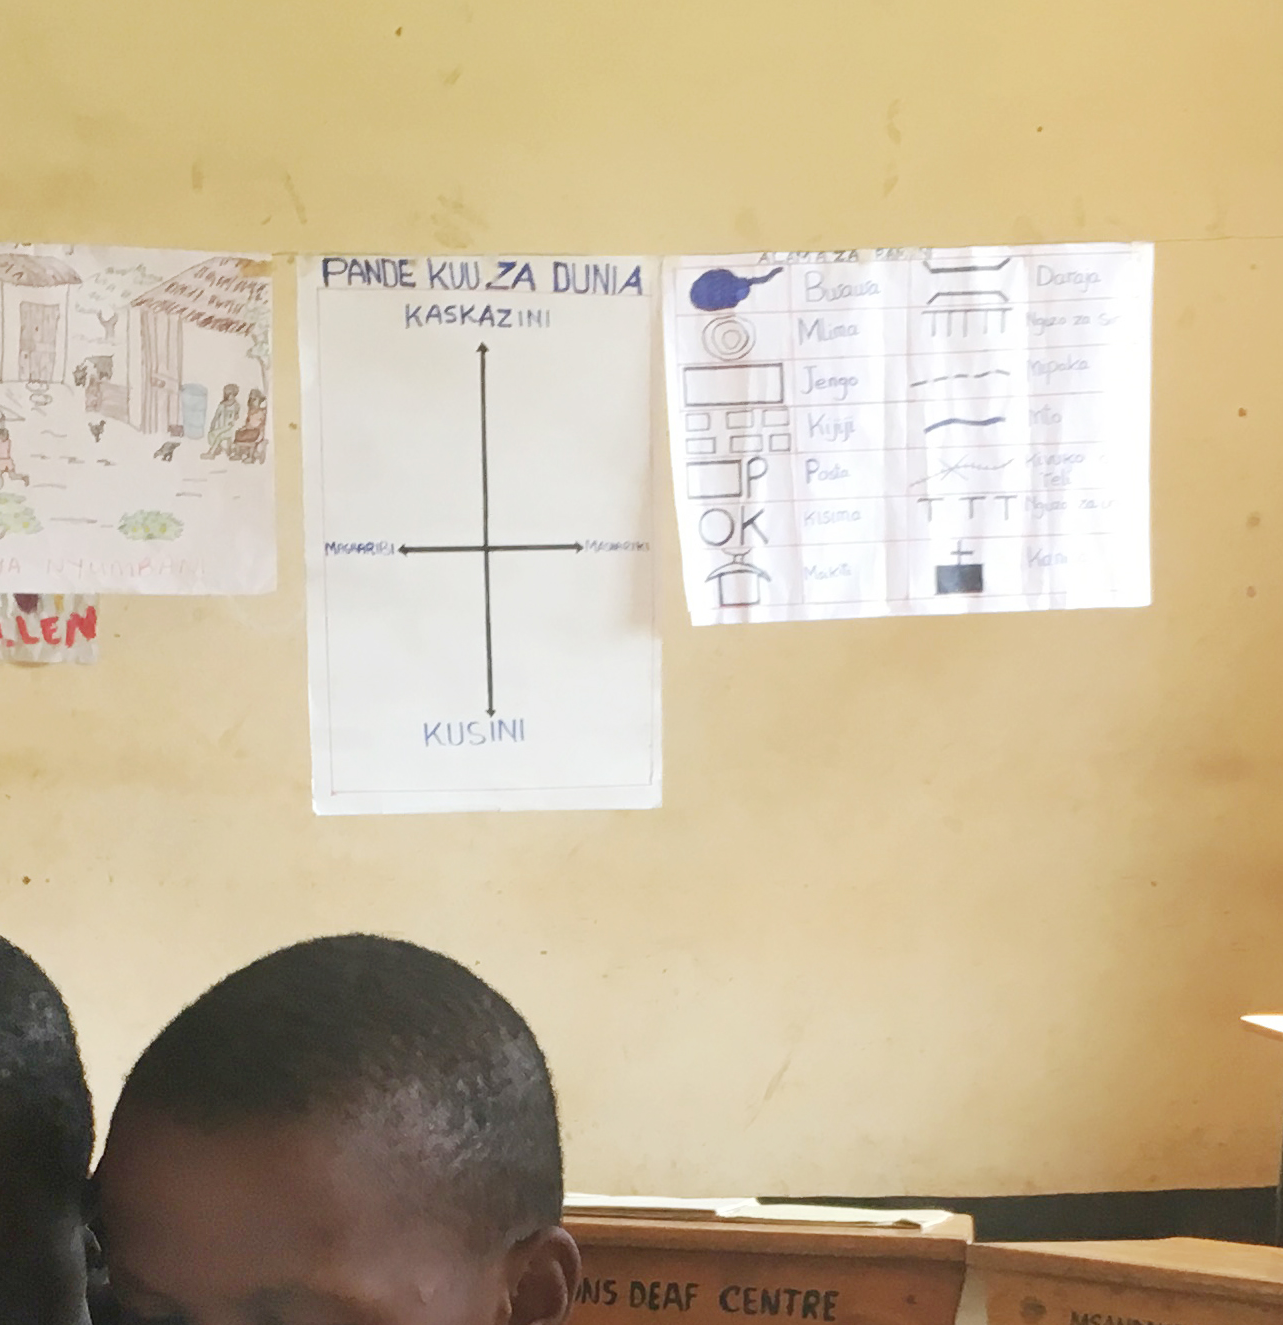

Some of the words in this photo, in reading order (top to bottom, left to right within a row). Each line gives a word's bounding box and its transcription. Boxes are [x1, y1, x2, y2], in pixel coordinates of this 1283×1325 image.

[322, 257, 416, 288] PANDE
[426, 258, 480, 290] KUU
[485, 260, 536, 291] ZA
[552, 261, 644, 296] DUNIA
[1036, 264, 1101, 293] Daraja
[405, 303, 551, 329] KASKAZINI
[800, 365, 858, 401] Jengo
[807, 413, 855, 442] Kijiji
[805, 458, 851, 484] Posta
[423, 717, 526, 746] KUSINI
[629, 1280, 700, 1313] DEAF
[718, 1283, 840, 1323] CENTRE
